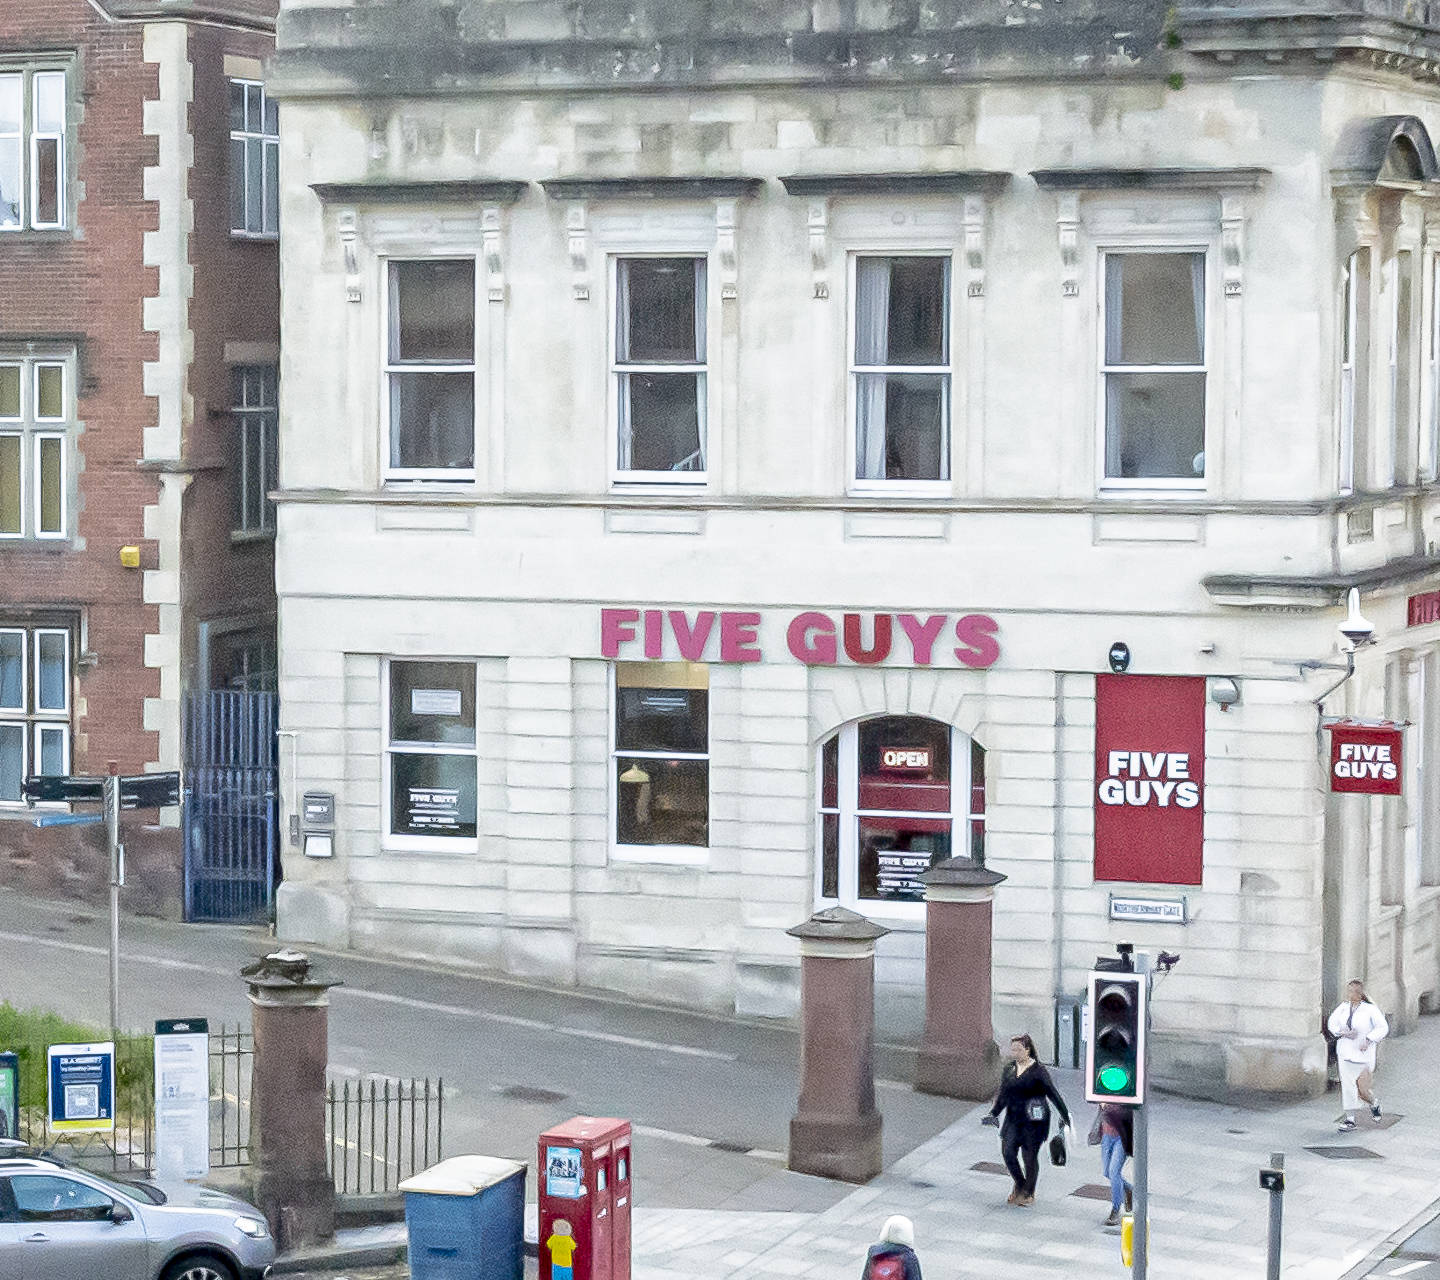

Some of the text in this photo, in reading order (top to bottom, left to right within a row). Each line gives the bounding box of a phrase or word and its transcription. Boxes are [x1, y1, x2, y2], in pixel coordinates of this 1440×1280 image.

[600, 609, 1001, 668] FIVE GUYS
[883, 750, 928, 768] OPEN
[1340, 744, 1391, 761] FIVE
[1108, 751, 1189, 779] FIVE
[1333, 761, 1398, 780] GUYS
[1098, 779, 1200, 808] GUYS
